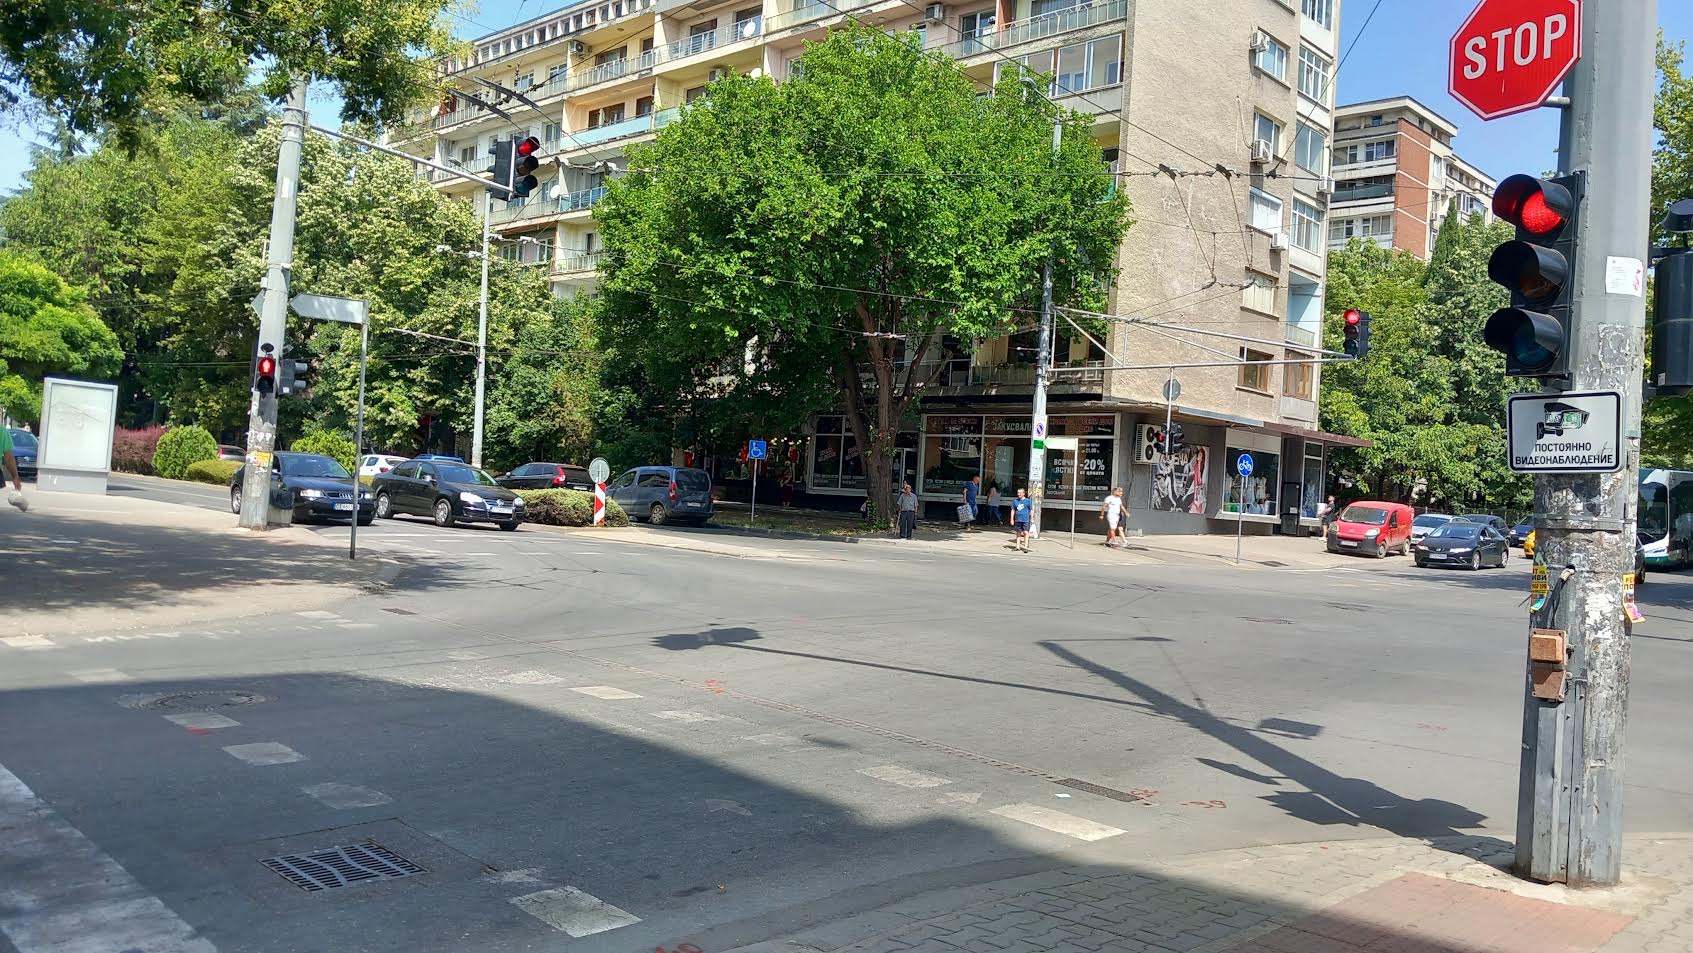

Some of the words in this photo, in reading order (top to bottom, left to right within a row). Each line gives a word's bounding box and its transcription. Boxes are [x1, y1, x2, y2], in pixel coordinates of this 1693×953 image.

[1463, 13, 1567, 80] STOP
[992, 422, 1033, 431] ЗАКУСВАЛ
[1534, 442, 1592, 453] ПОСТОЯННО
[1079, 458, 1106, 471] -20%
[1515, 454, 1614, 466] ВИДЕОНАБЛЮДЕНИЕ
[1625, 576, 1634, 584] РЕ
